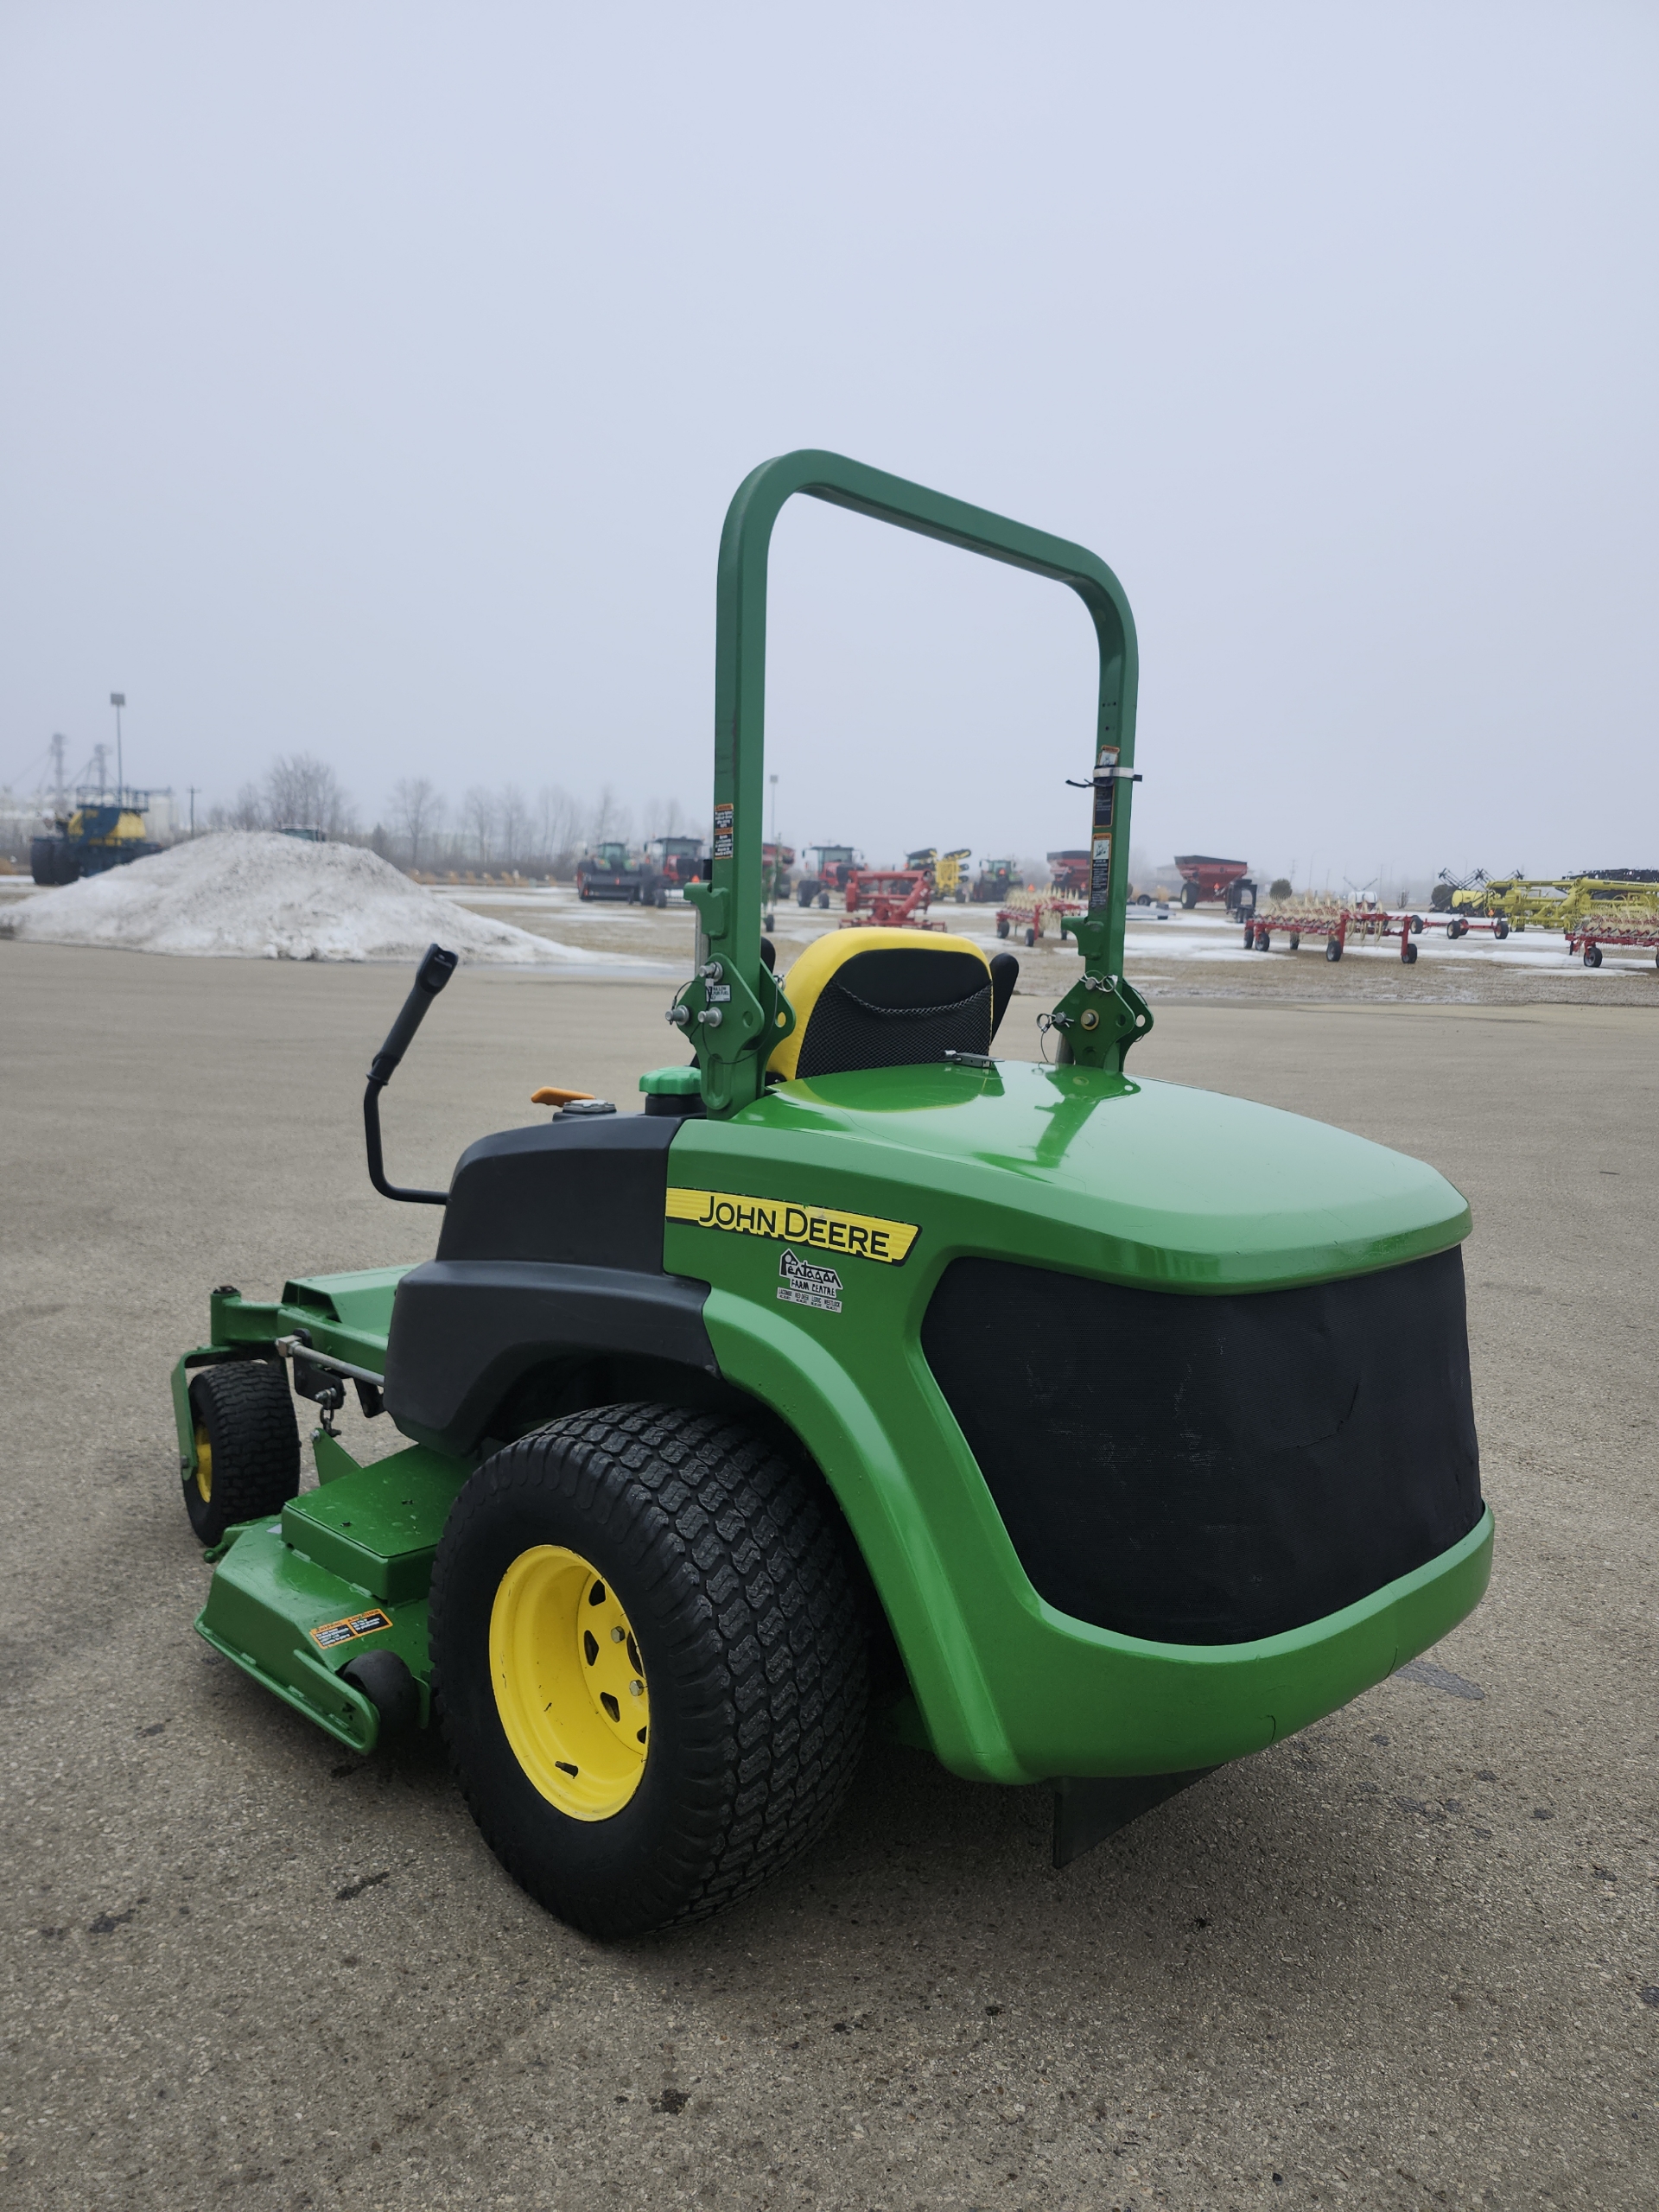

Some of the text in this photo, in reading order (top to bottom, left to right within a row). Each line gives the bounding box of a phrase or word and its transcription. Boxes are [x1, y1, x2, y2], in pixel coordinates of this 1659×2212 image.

[699, 1195, 890, 1257] JOHN DEERE
[791, 1279, 836, 1296] FARM CENTRE
[823, 1299, 841, 1307] WESTLOCK
